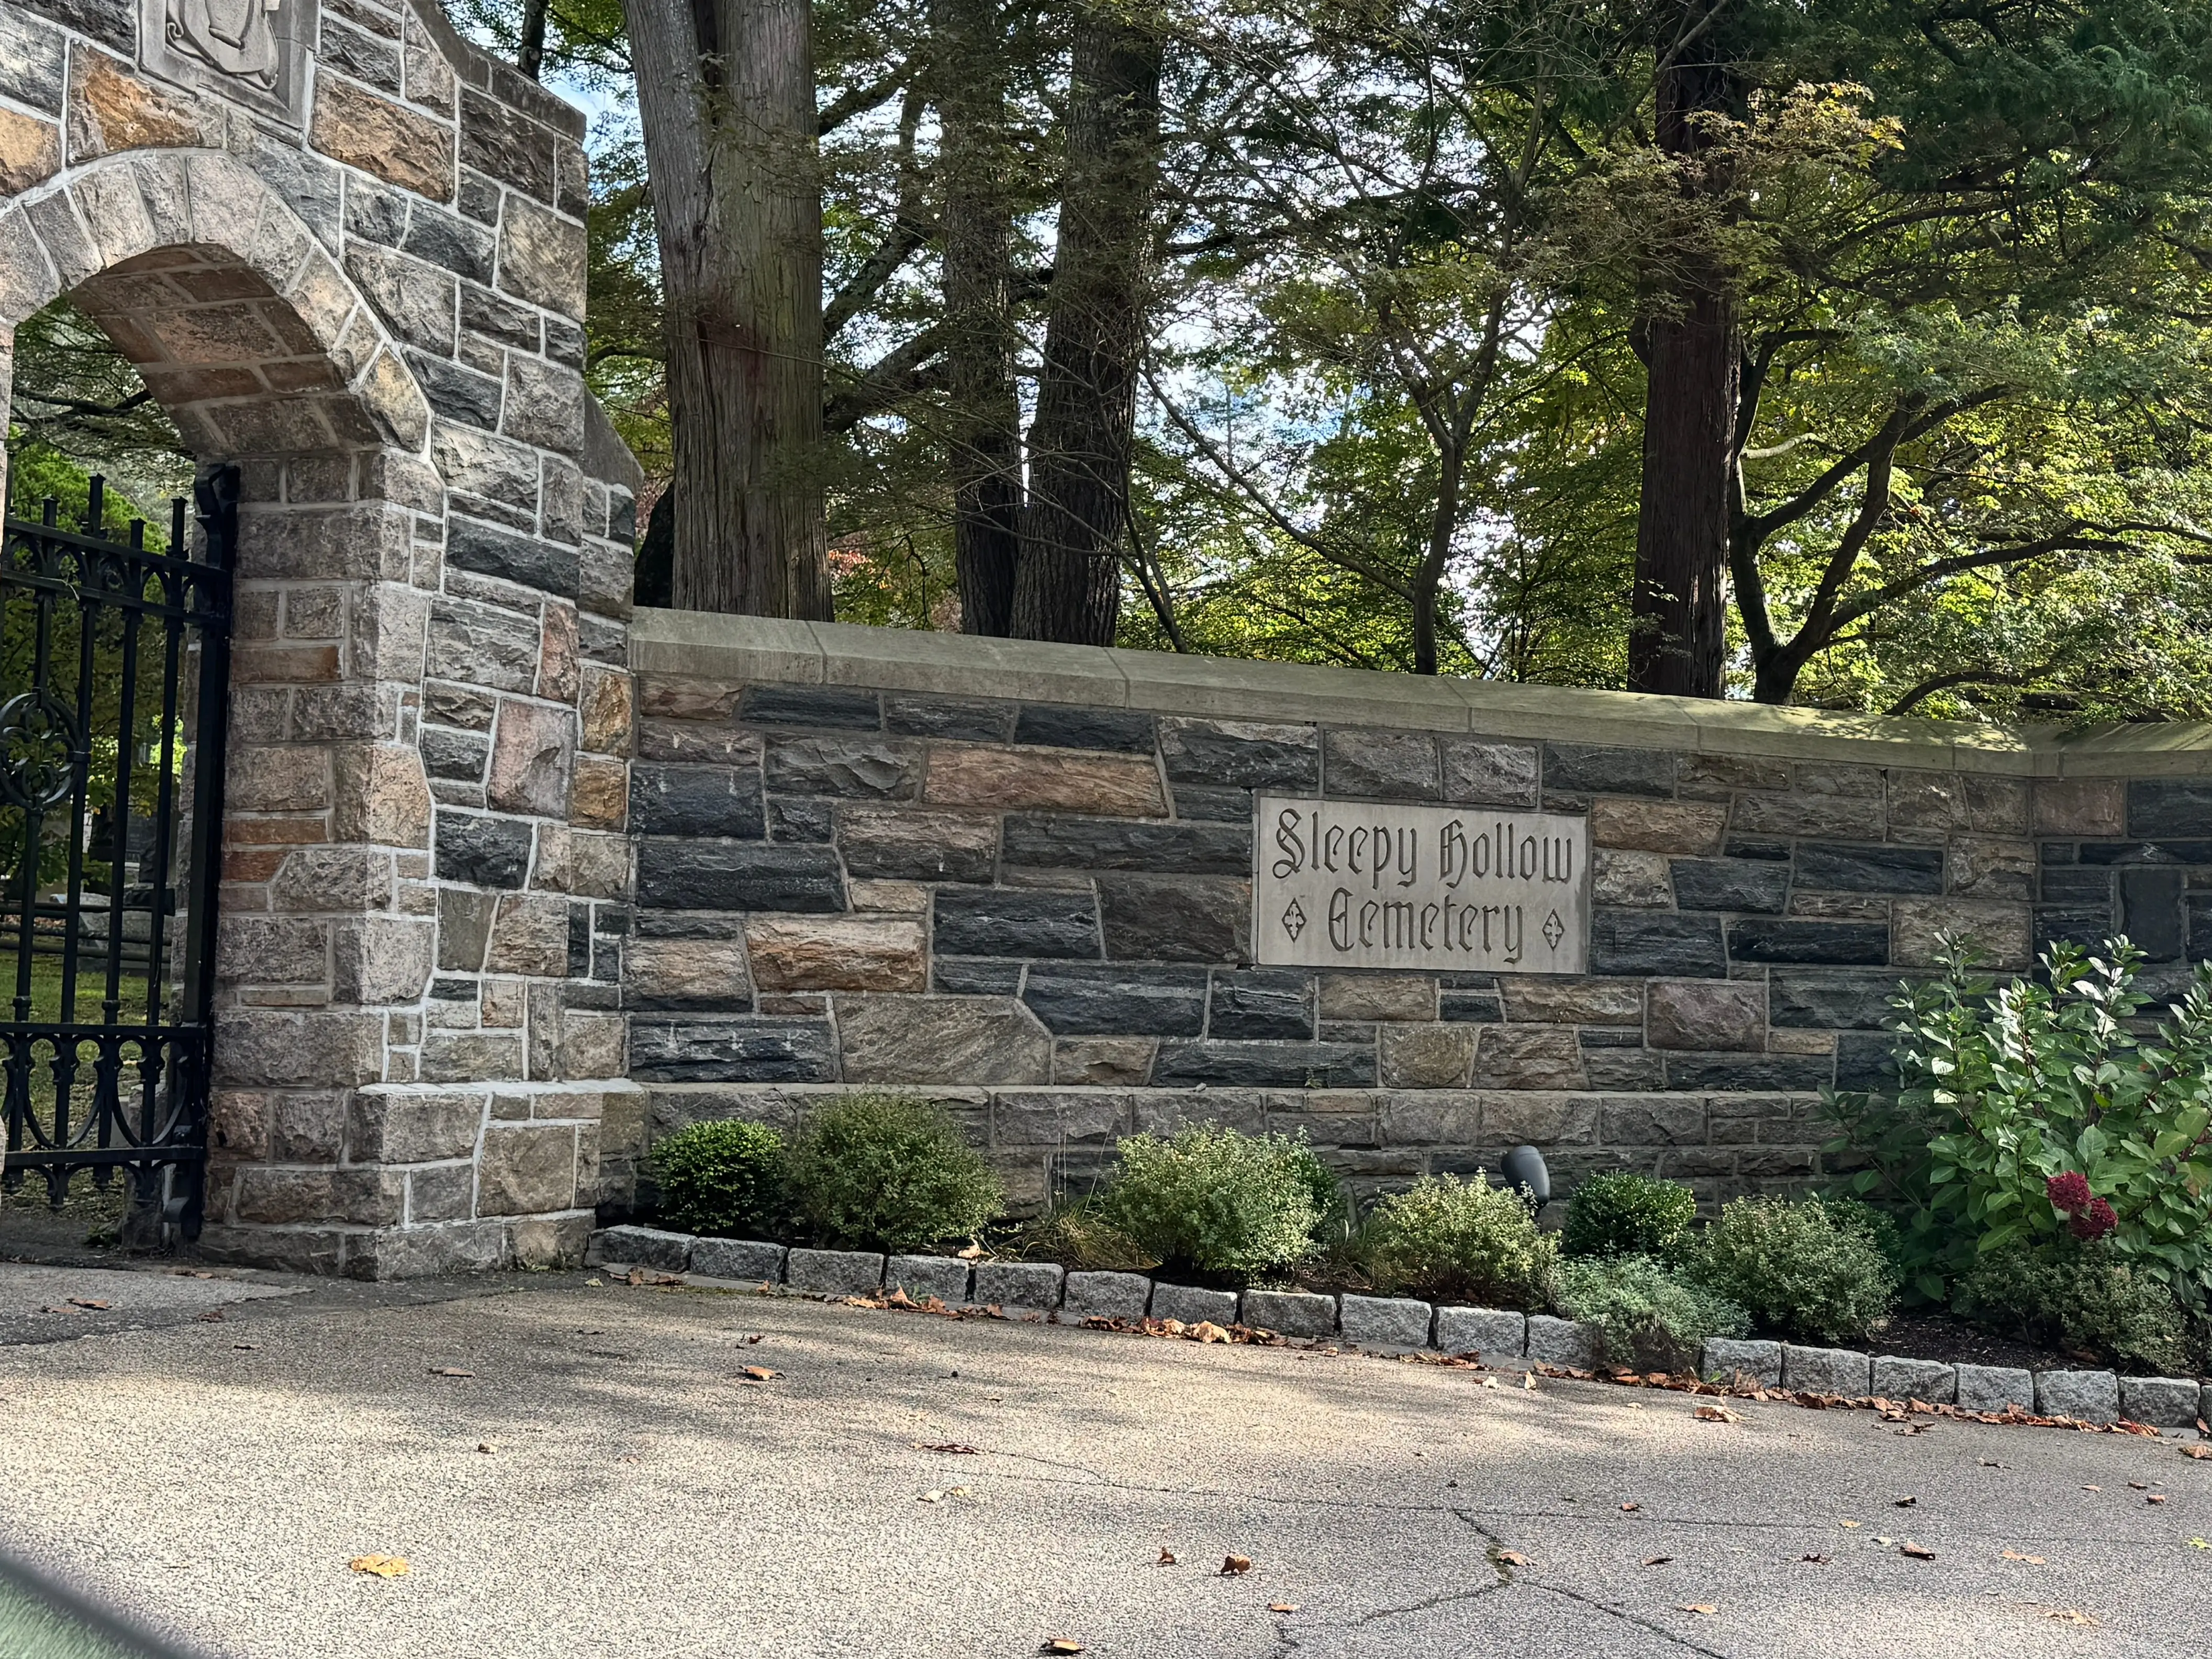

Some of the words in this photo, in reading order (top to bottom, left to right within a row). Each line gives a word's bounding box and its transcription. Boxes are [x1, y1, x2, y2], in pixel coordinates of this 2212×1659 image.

[1272, 808, 1417, 890] Sleepy
[1439, 819, 1572, 888] Hollow
[1328, 887, 1523, 964] Cemetery
